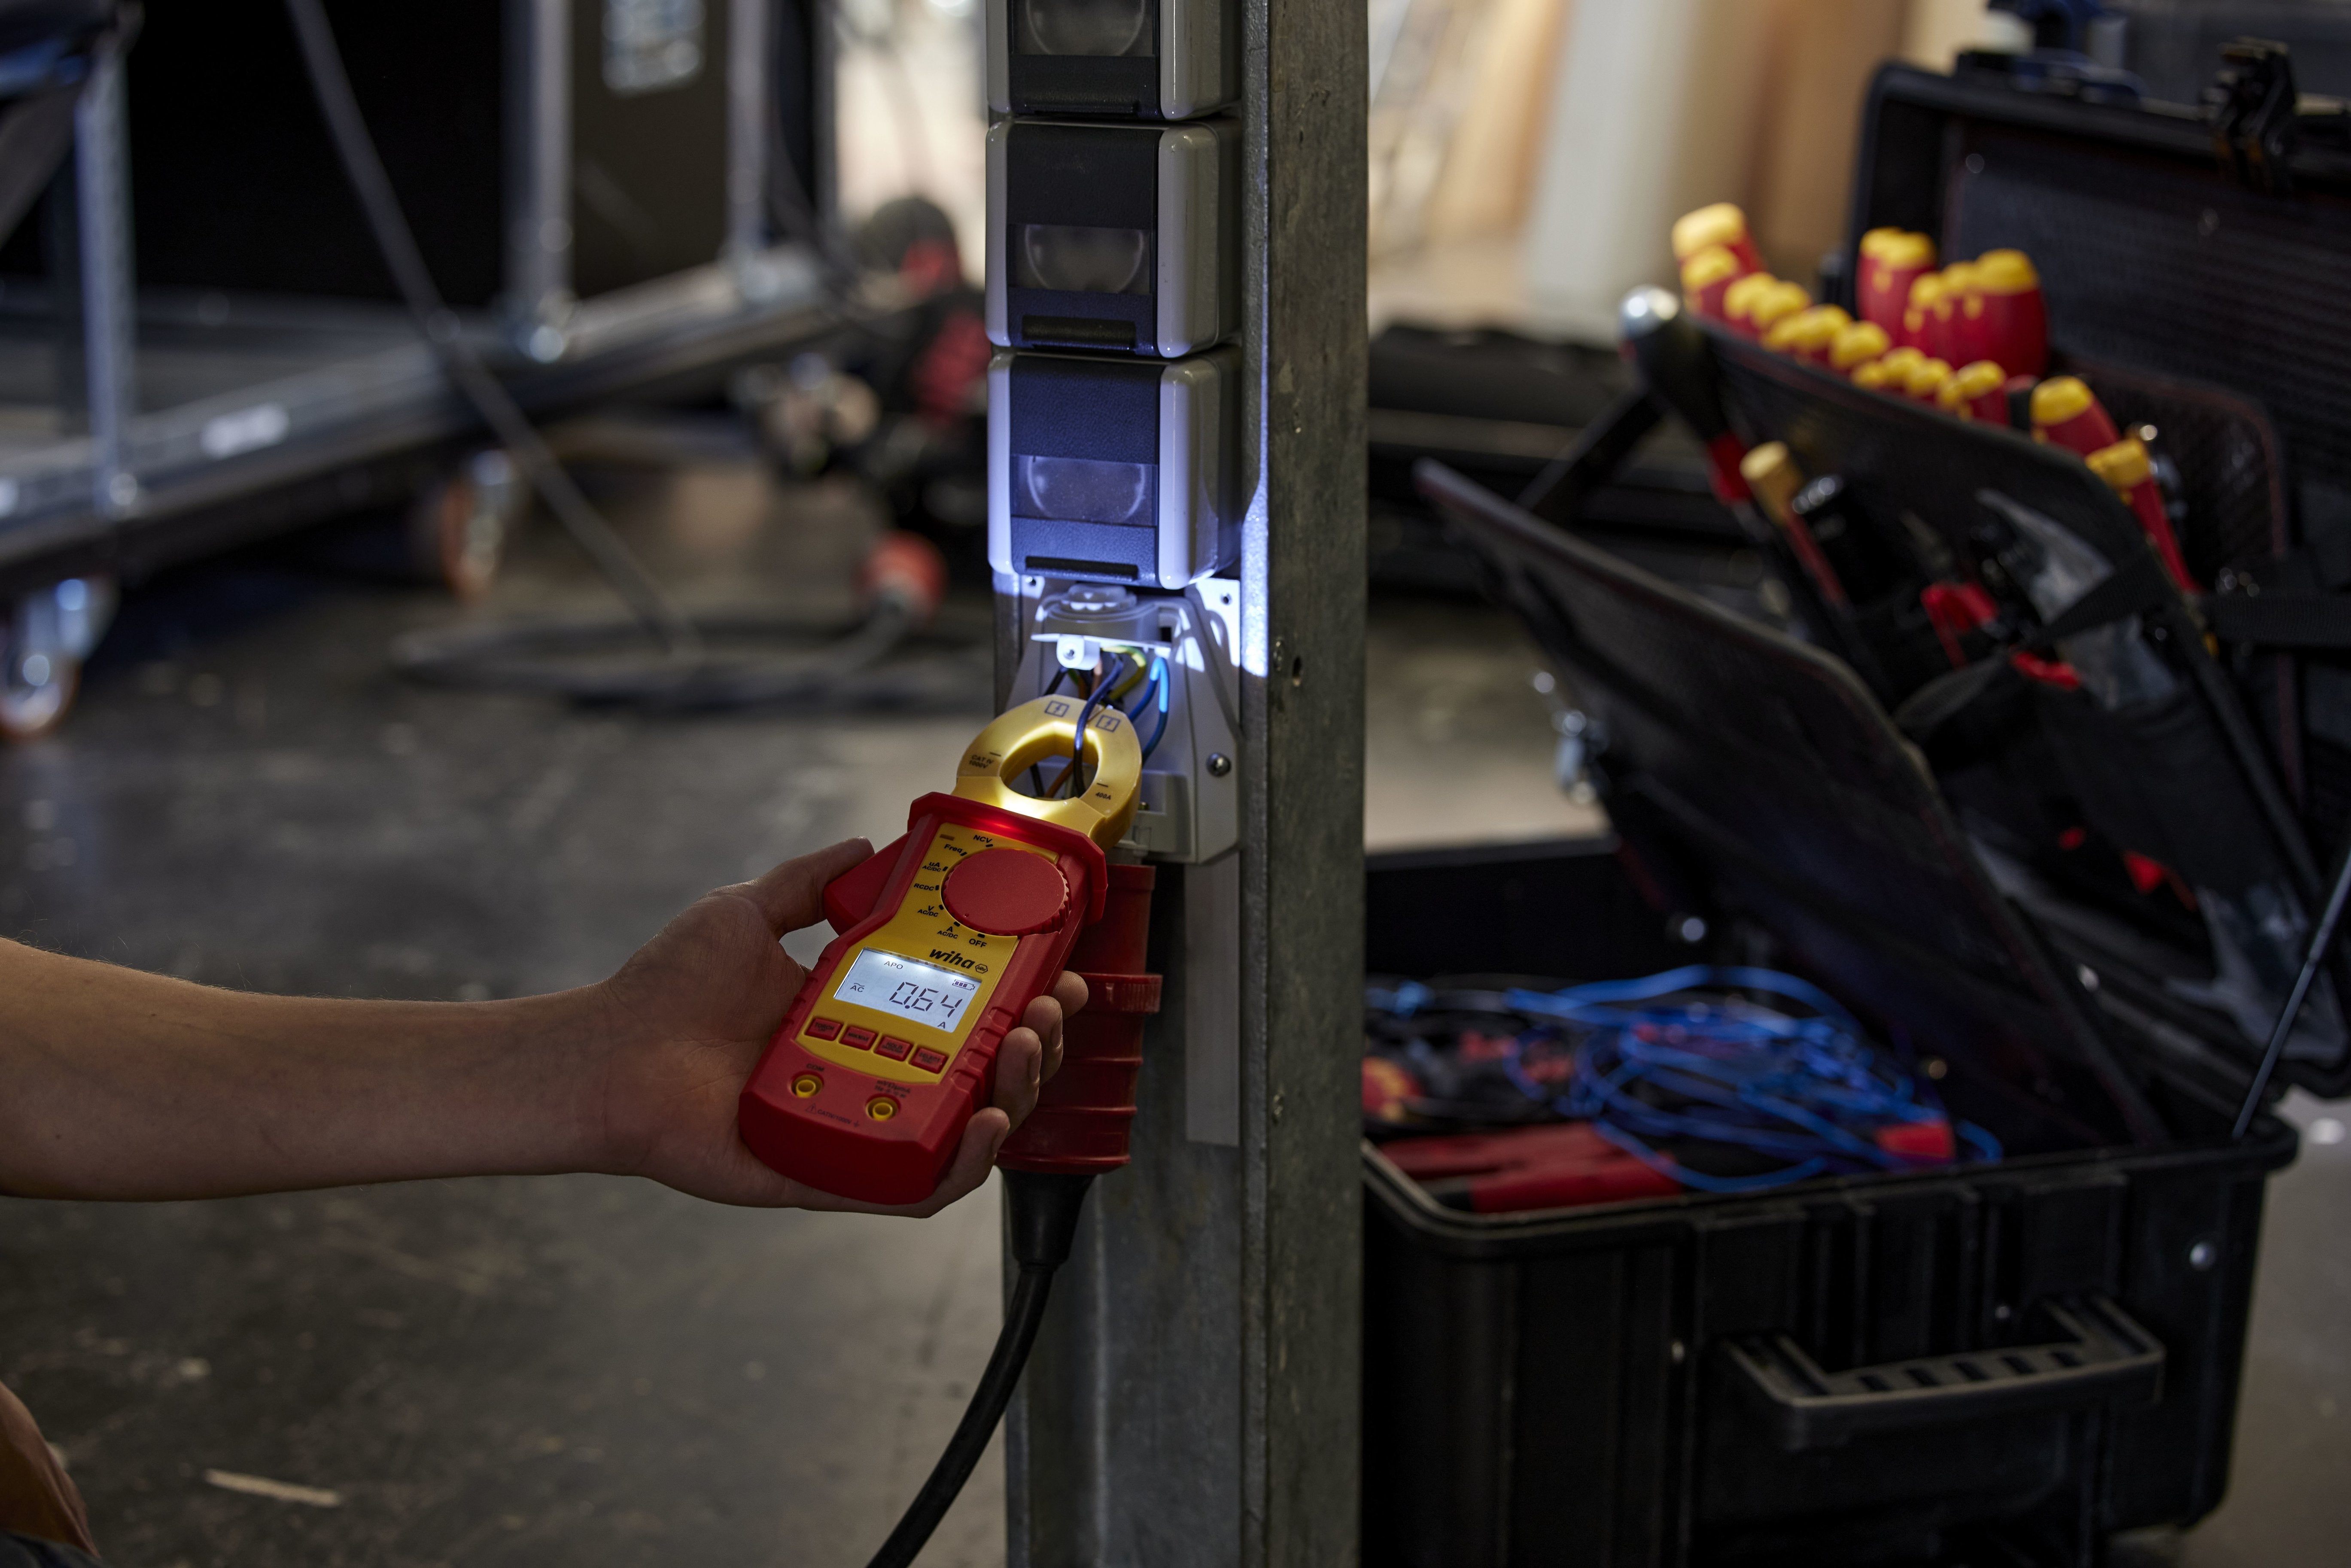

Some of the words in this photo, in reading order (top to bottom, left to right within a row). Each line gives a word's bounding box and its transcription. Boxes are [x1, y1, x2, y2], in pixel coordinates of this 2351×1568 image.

[973, 835, 992, 843] NCV
[944, 844, 962, 853] Freq
[917, 909, 939, 917] AC/DC
[937, 930, 958, 939] AC/DC
[969, 939, 987, 948] OFF
[929, 949, 975, 969] wiha
[889, 982, 963, 1018] 0.64
